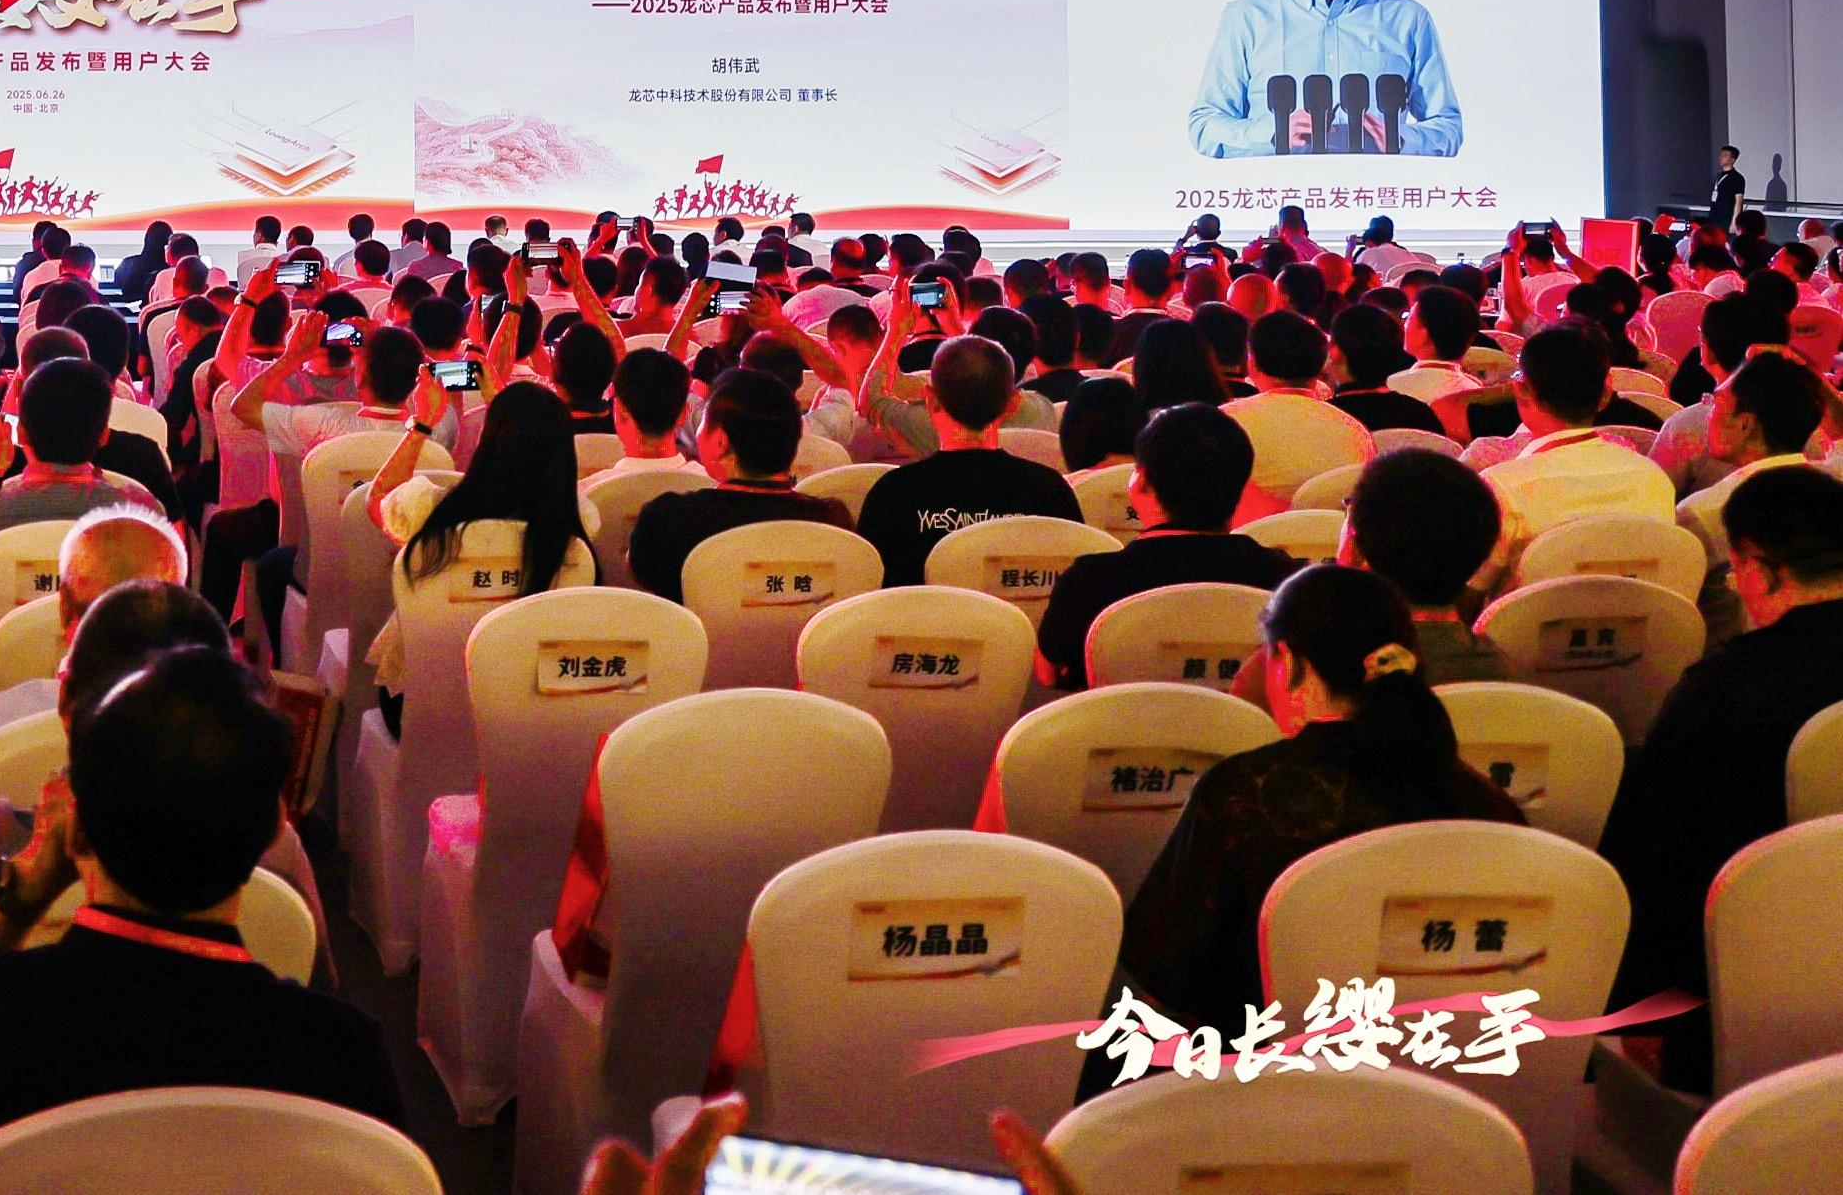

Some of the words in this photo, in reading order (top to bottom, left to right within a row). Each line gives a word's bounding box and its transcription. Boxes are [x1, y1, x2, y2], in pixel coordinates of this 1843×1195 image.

[711, 57, 761, 75] 胡伟武
[6, 89, 66, 100] 2025.06.26
[628, 88, 792, 103] 龙芯中科技术股份有限公司
[798, 88, 838, 102] 董事长
[1175, 186, 1498, 209] 2025龙芯产品发布暨用户大会
[558, 656, 627, 678] 刘金虎
[891, 653, 960, 675] 房海龙
[882, 923, 989, 958] 杨晶晶
